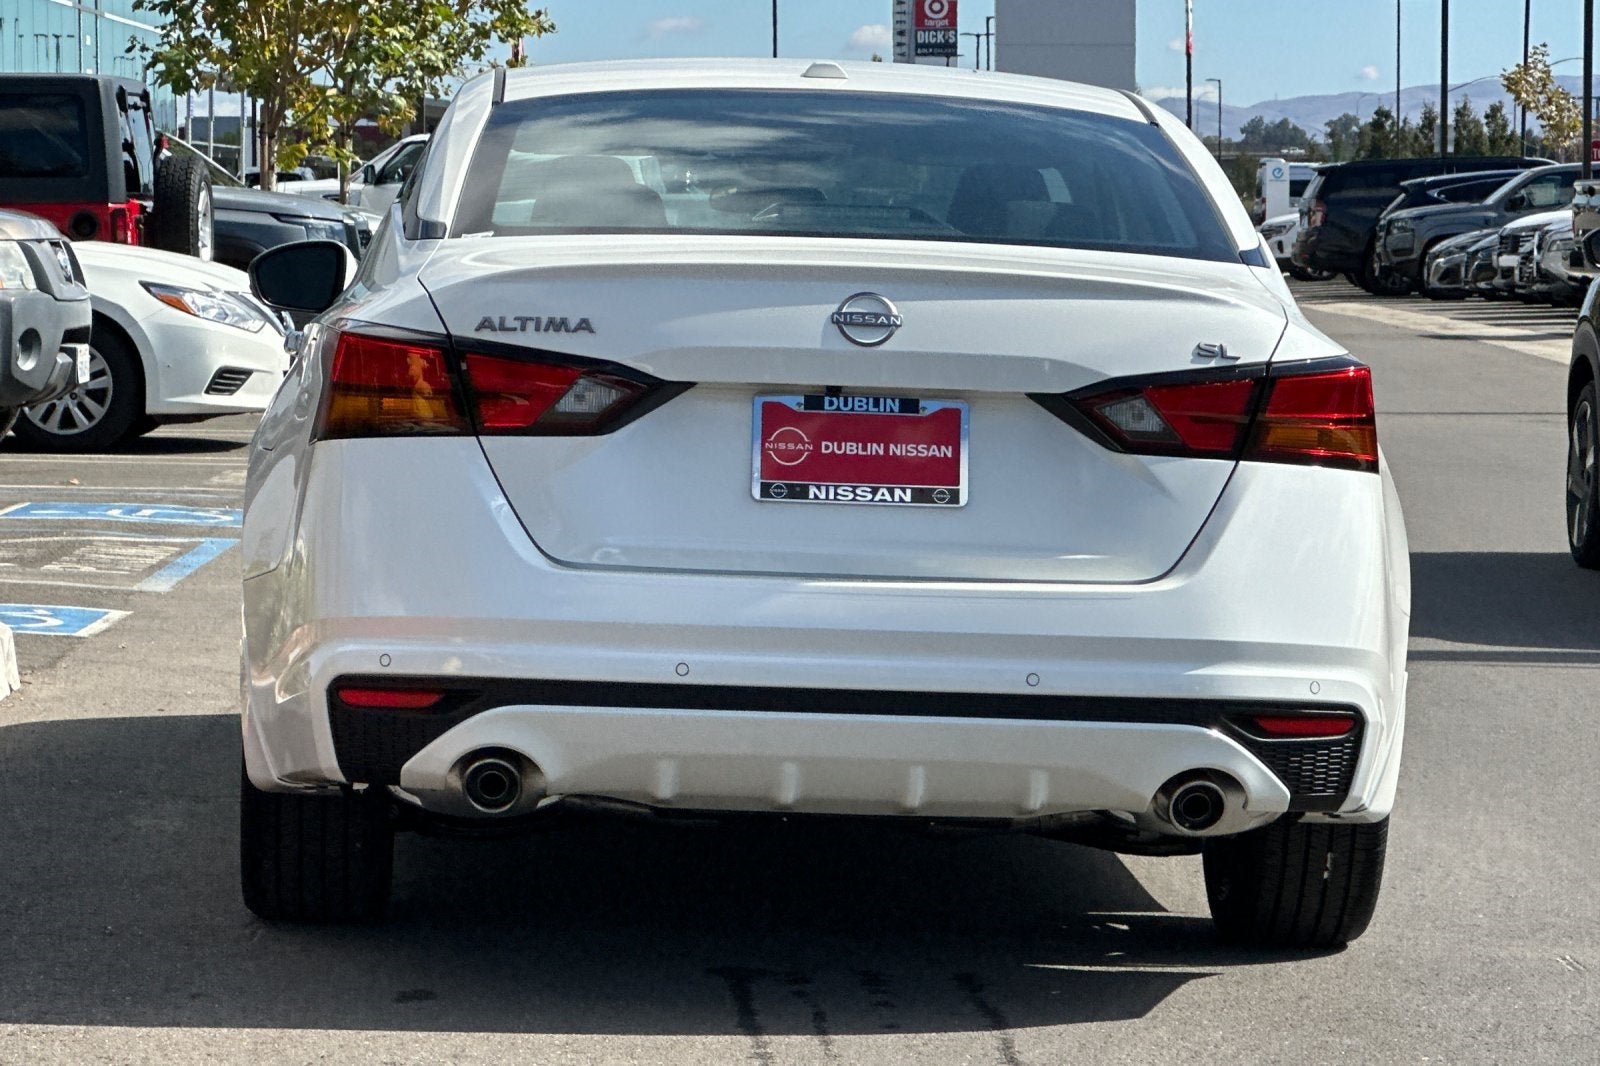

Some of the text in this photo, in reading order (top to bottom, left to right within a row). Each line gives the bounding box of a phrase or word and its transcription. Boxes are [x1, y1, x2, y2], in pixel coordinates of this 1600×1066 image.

[924, 19, 949, 29] target
[917, 30, 956, 44] DICK'S
[474, 315, 596, 334] ALTIMA
[832, 313, 902, 326] NISSAN
[1195, 342, 1241, 360] SL
[823, 396, 900, 413] DUBLIN
[765, 442, 814, 451] NISSAN
[821, 441, 953, 458] DUBLIN NISSAN
[808, 485, 912, 503] NISSAN
